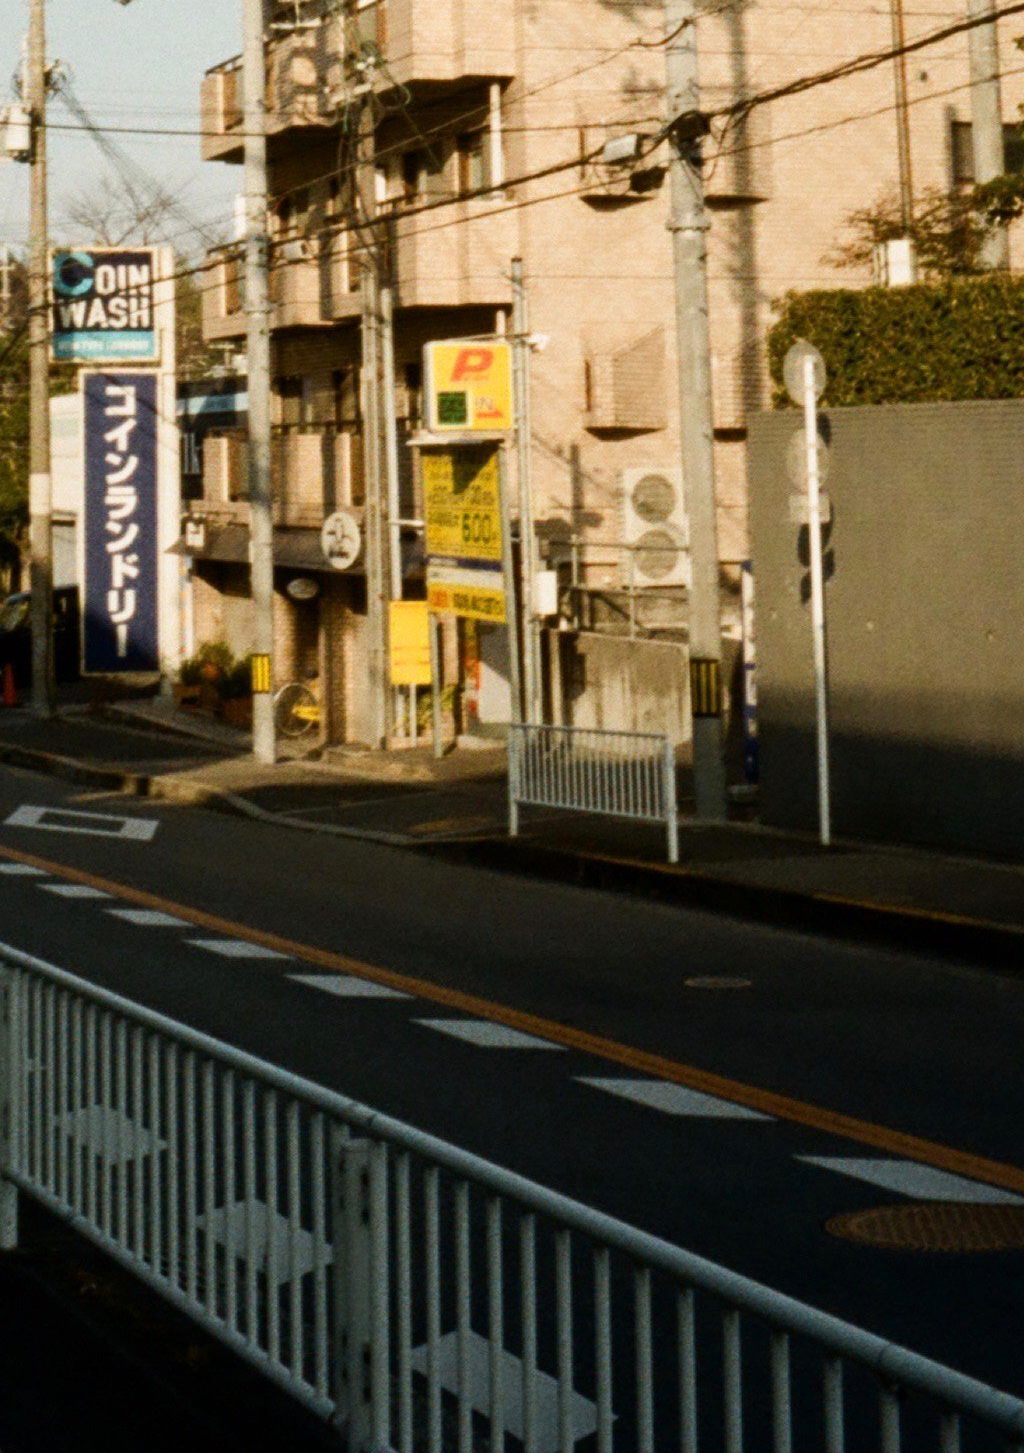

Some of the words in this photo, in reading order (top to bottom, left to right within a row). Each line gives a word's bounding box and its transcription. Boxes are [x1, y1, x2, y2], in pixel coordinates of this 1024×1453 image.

[53, 252, 150, 296] COIN
[56, 296, 150, 329] WASH
[450, 348, 494, 382] P
[104, 385, 140, 658] コインランドリー
